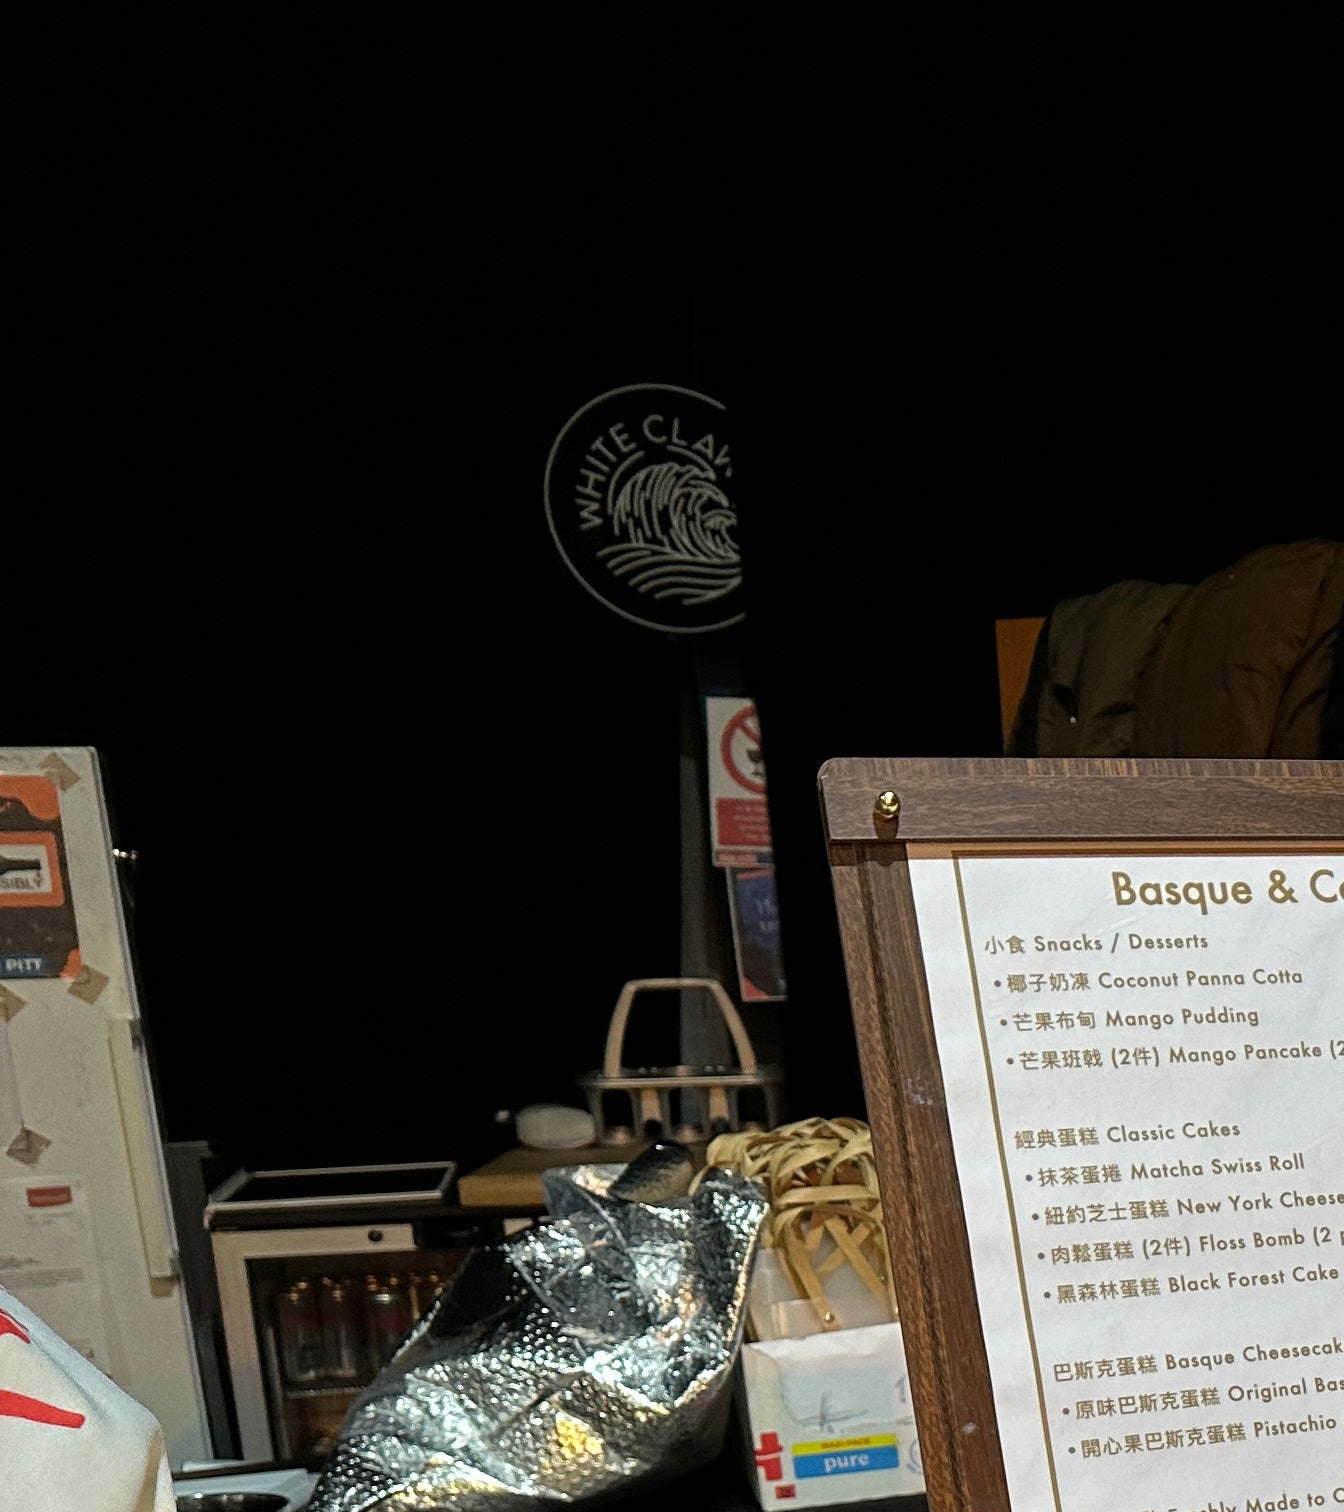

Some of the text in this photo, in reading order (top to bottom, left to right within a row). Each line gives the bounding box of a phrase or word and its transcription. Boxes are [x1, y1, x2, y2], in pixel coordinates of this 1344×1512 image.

[575, 422, 637, 530] WHITE
[1111, 871, 1253, 916] Basque
[1267, 869, 1299, 904] &
[984, 935, 1025, 955] 小食
[1033, 933, 1103, 952] Snacks
[1128, 933, 1208, 950] Desserts
[1006, 968, 1303, 993] 椰子奶凍 Coconut Panna Cotta
[1012, 1005, 1259, 1032] 芒果布甸 Mango Pudding
[1018, 1048, 1103, 1070] 芒果班戟
[1111, 1046, 1159, 1069] (2件)
[1169, 1046, 1236, 1066] Mango
[1243, 1040, 1322, 1060] Pancake
[1013, 1119, 1240, 1149] 經典蛋糕 Classic Cakes
[1037, 1152, 1305, 1187] 抹茶蛋捲 Matcha Swiss Roll
[1044, 1199, 1170, 1226] 紐約芝士蛋糕
[1176, 1198, 1222, 1215] New
[1227, 1191, 1273, 1211] York
[1051, 1240, 1134, 1265] 肉鬆蛋糕
[1142, 1235, 1191, 1260] (2件)
[1199, 1233, 1246, 1252] Floss
[1252, 1227, 1305, 1248] Bomb
[1312, 1226, 1332, 1247] (2
[1057, 1263, 1339, 1304] 黑森林蛋糕 Black Forest Cake
[1053, 1354, 1158, 1382] 巴斯克蛋糕
[1165, 1353, 1235, 1371] Basque
[1227, 1377, 1307, 1403] Original
[1253, 1414, 1337, 1438] Pistachio
[823, 1452, 870, 1474] pure
[1306, 1493, 1325, 1507] to
